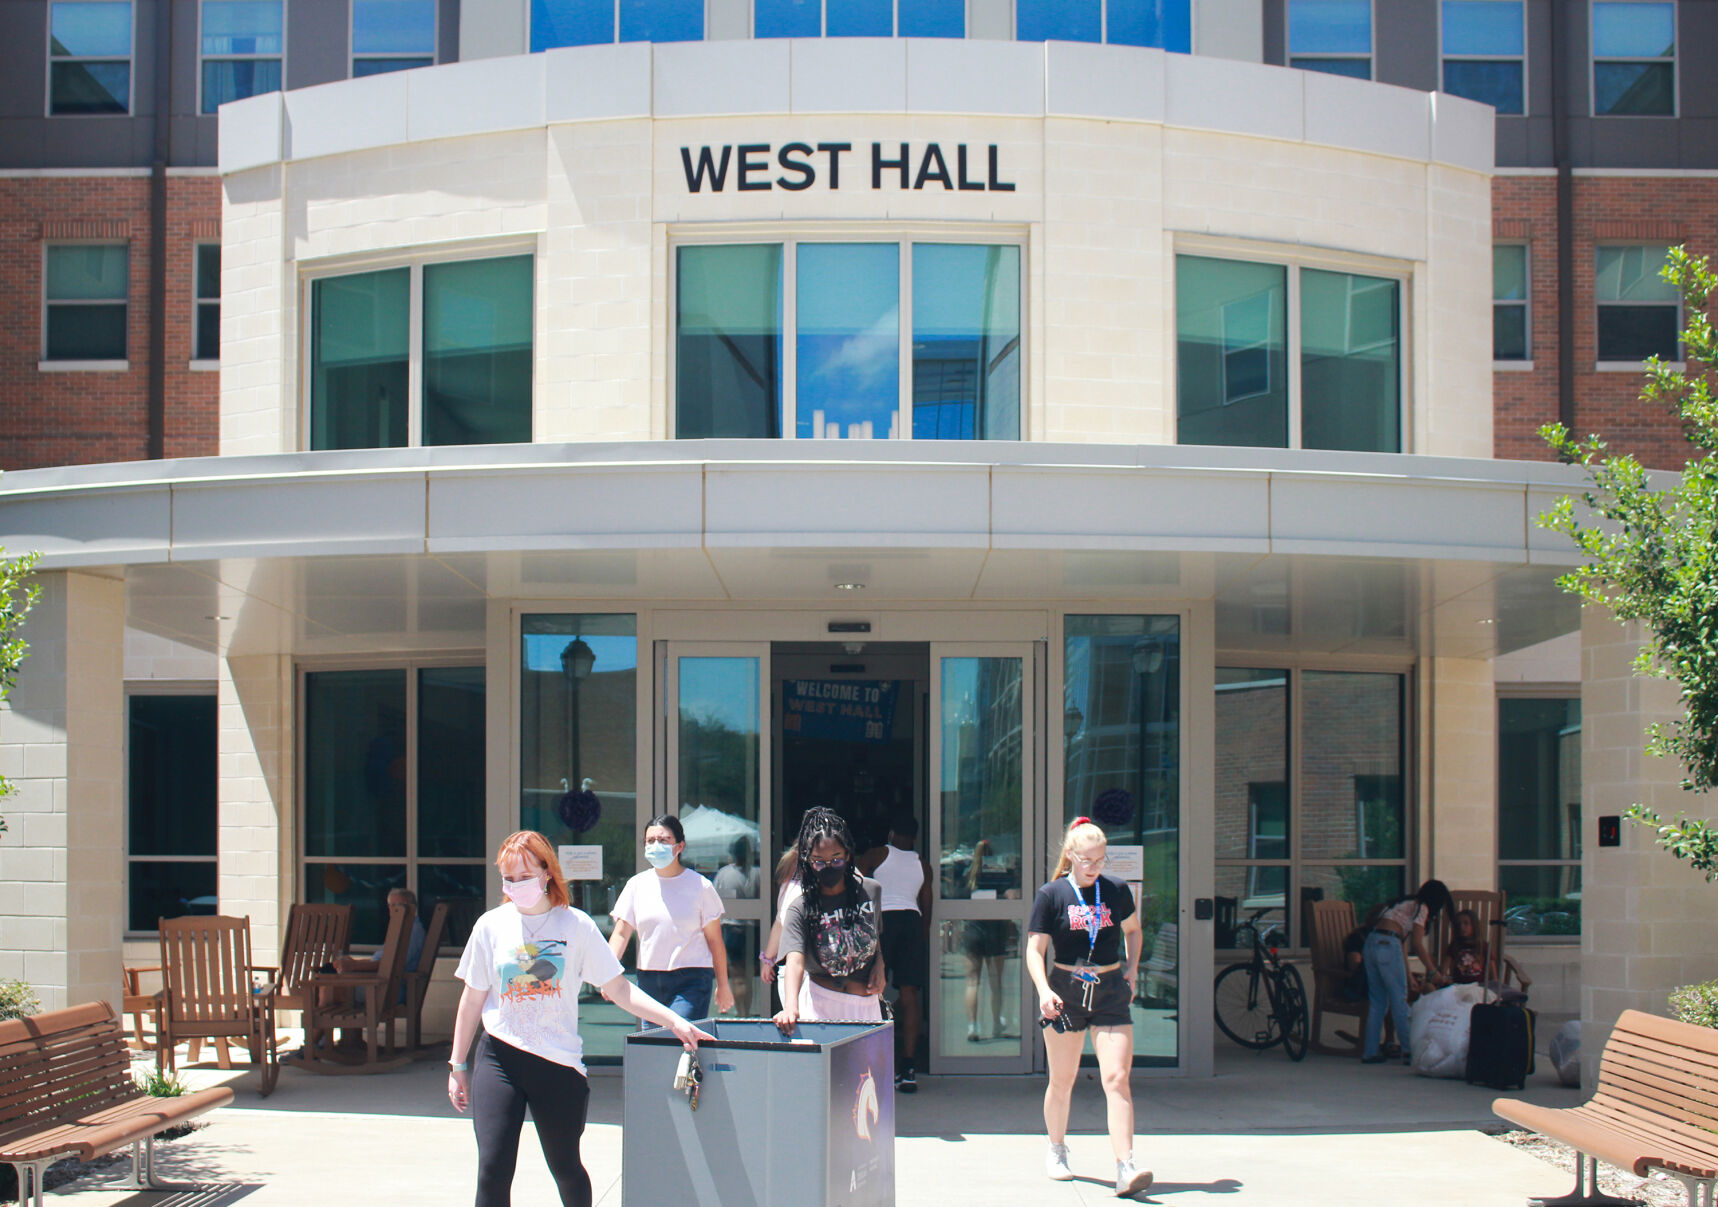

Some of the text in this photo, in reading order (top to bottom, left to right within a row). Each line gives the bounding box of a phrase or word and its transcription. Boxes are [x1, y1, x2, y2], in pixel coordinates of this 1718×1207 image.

[680, 142, 1016, 193] WEST HALL
[796, 681, 880, 703] WELCOME TO
[789, 699, 836, 714] WEST
[840, 703, 883, 719] HALL
[1067, 902, 1112, 916] SCOL
